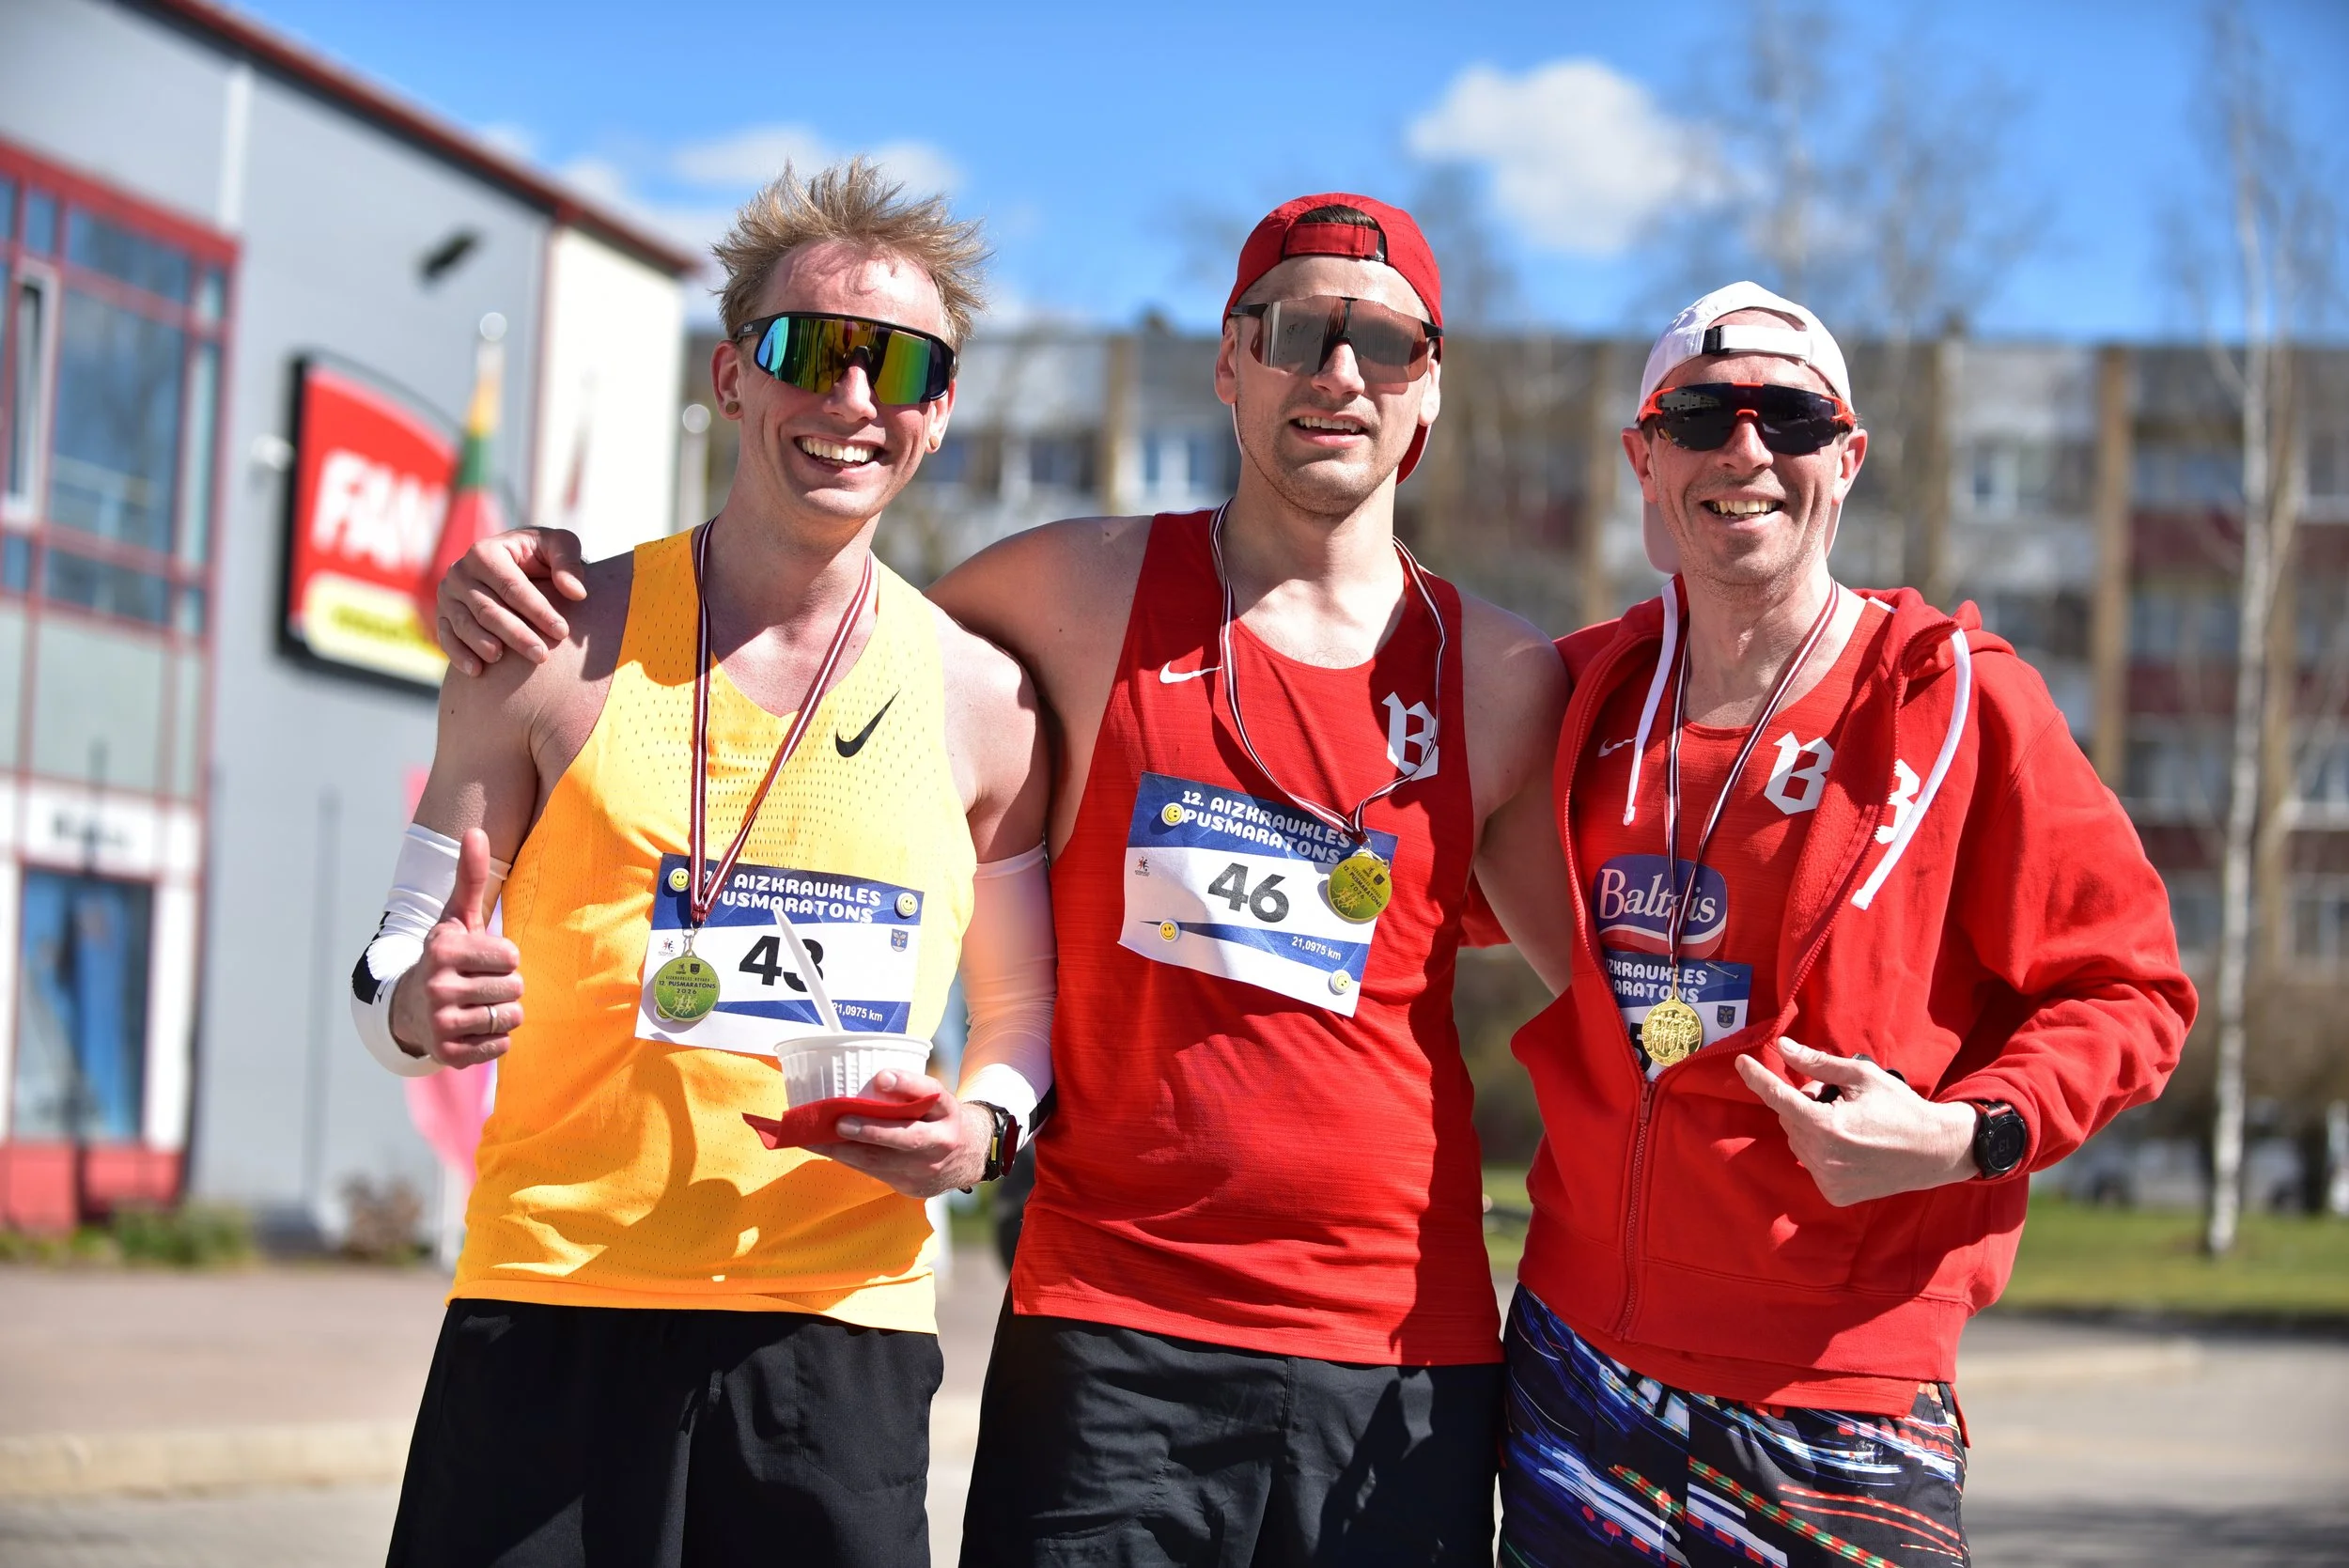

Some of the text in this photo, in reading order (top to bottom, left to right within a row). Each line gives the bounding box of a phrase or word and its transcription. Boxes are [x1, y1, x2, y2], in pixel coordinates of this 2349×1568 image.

[1764, 730, 1835, 815] B
[1182, 790, 1351, 848] 12. AIZKRAUKLES
[1182, 808, 1342, 864] PUSMARATONS
[717, 890, 873, 924] USMARATONS
[734, 873, 881, 907] AIZKRAUKLES
[1207, 862, 1290, 923] 46
[1349, 872, 1383, 908] PUSMARATONS
[739, 935, 824, 992] 43
[1291, 936, 1342, 961] 21,0975 km
[668, 981, 716, 989] PUSMARATONS
[1611, 979, 1700, 1003] ARATONS
[868, 1009, 883, 1022] km
